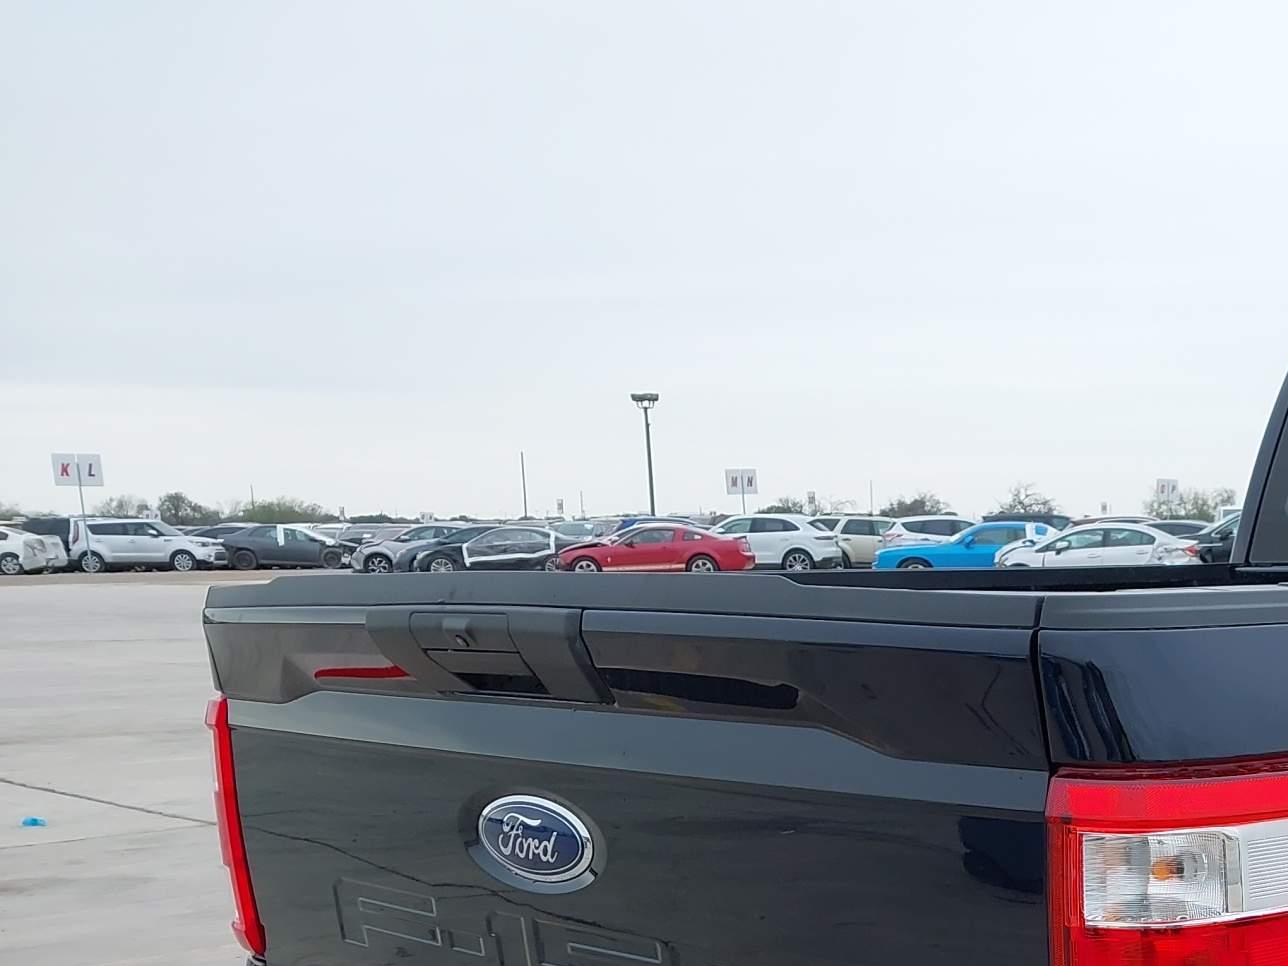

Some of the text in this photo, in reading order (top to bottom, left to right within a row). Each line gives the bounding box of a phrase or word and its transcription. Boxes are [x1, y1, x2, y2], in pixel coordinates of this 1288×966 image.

[60, 462, 96, 477] K L
[746, 475, 754, 488] N
[498, 811, 560, 865] Ford
